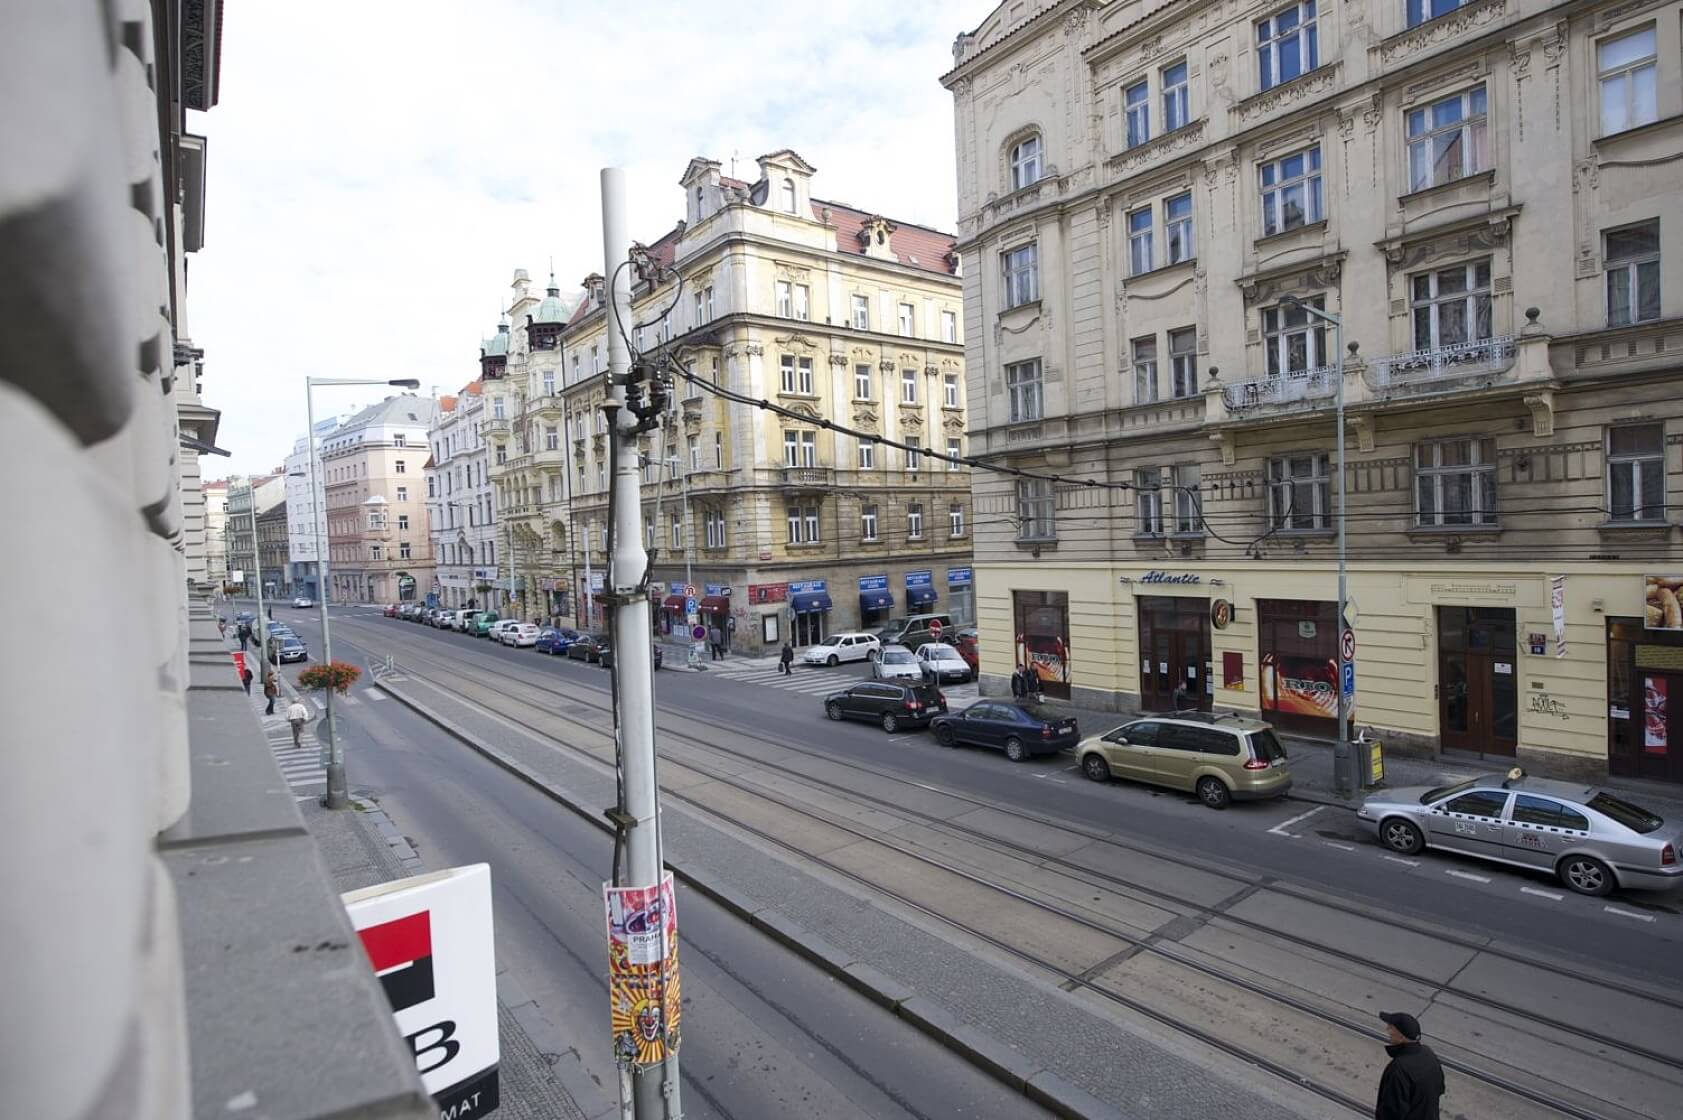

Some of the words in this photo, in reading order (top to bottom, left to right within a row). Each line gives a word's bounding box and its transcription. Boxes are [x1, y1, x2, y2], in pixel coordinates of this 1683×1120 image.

[1142, 570, 1200, 585] Atlantic
[1032, 652, 1060, 665] RIO
[1345, 666, 1352, 687] P
[1282, 678, 1331, 694] RIO
[632, 931, 662, 945] PRAH
[404, 1019, 460, 1075] B
